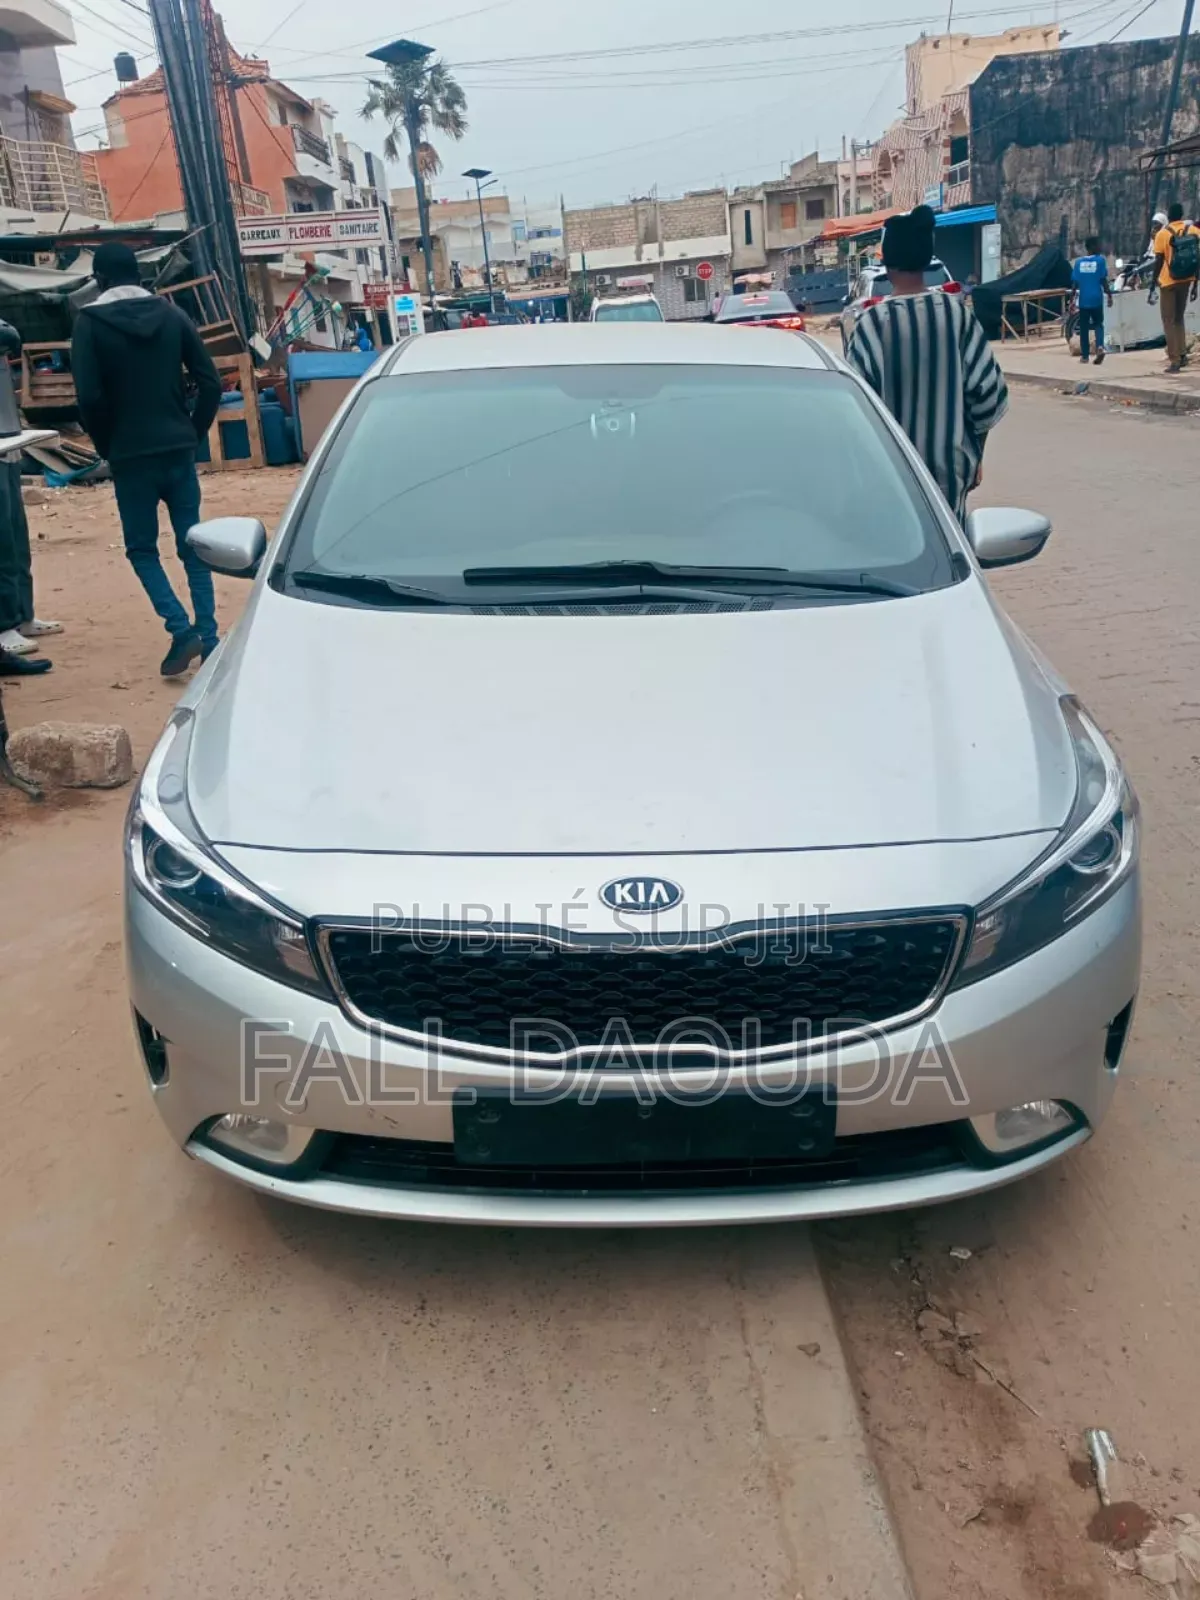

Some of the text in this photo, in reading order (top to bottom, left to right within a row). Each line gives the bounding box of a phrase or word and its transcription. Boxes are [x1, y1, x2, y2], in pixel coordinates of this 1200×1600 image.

[240, 222, 379, 241] CARREAUX PLOMBERIE SANITAIRE
[614, 882, 669, 904] KIA
